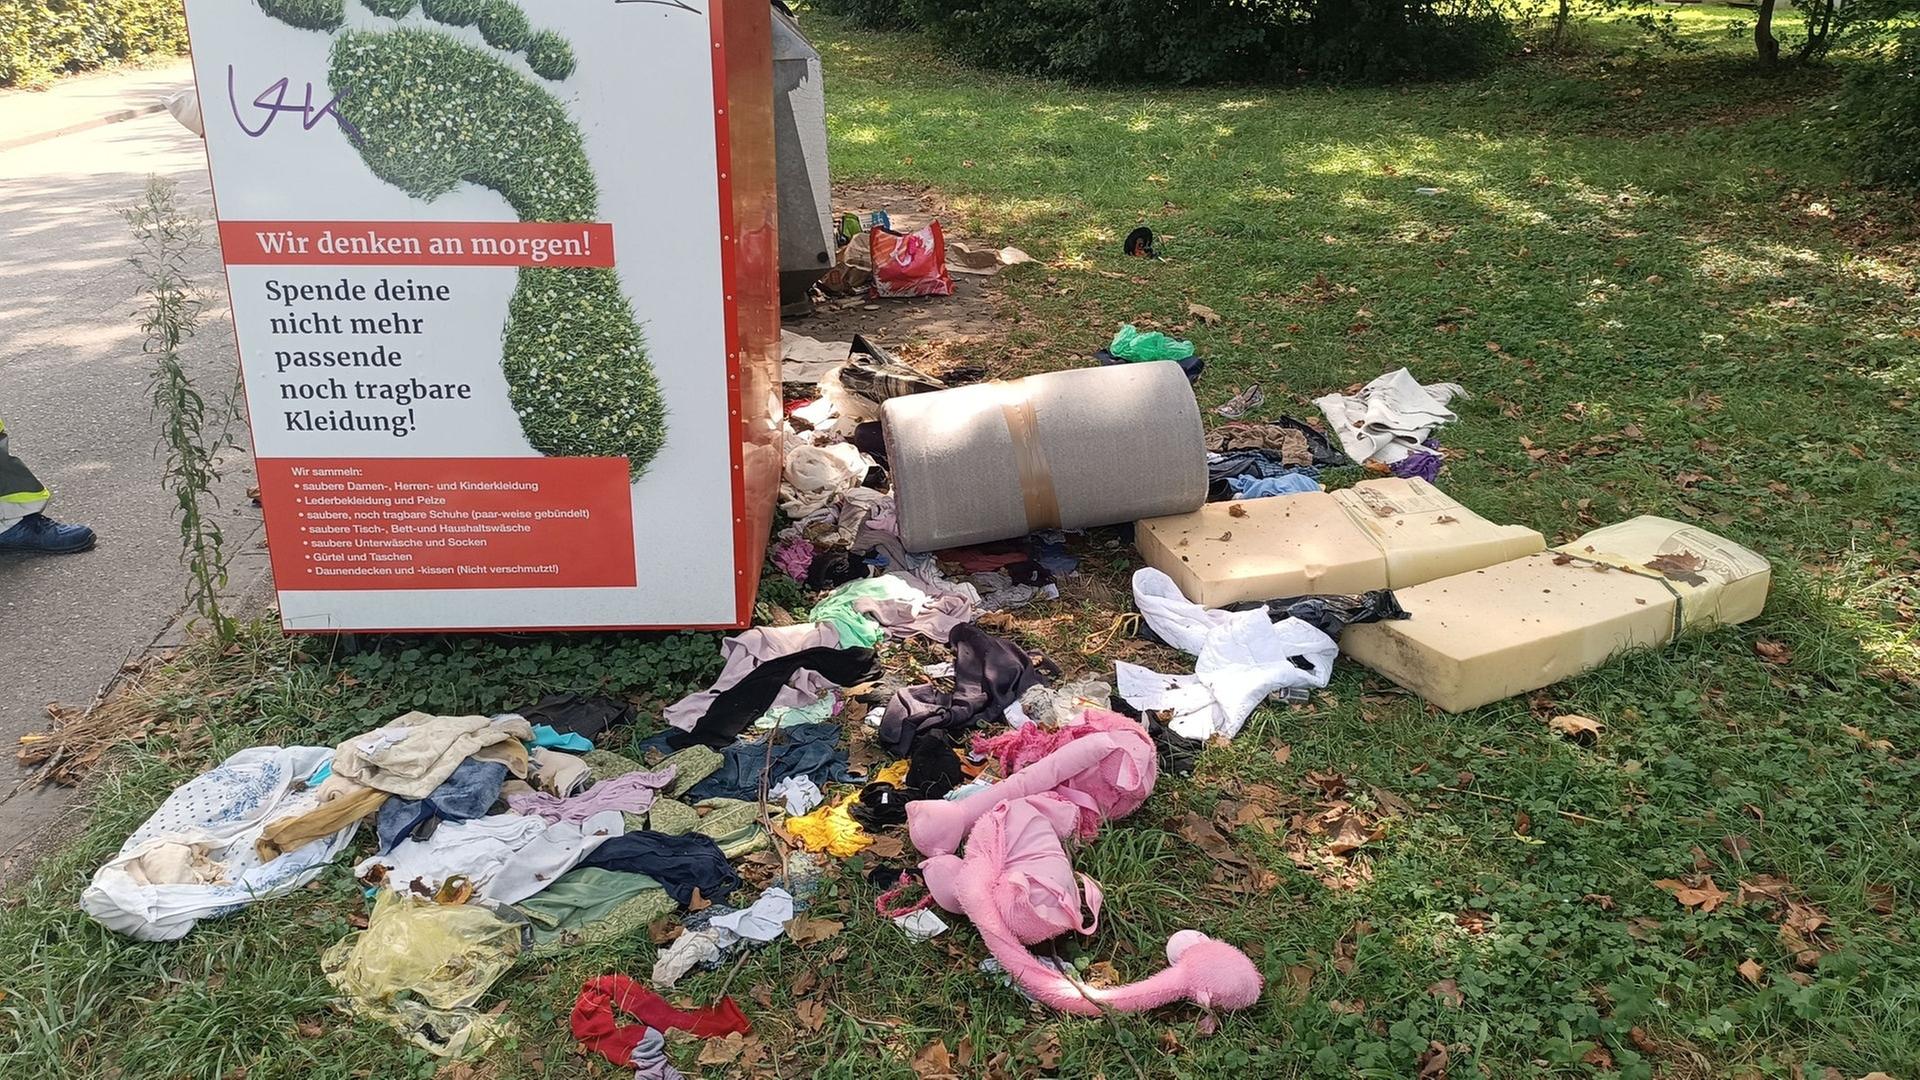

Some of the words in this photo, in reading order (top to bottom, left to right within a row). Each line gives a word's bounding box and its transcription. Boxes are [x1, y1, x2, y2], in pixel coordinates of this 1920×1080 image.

[256, 231, 308, 254] Wir
[317, 231, 421, 255] denken
[429, 237, 463, 255] an
[472, 231, 591, 261] morgen!
[266, 279, 366, 306] Spende
[374, 279, 450, 301] deine
[271, 313, 342, 334] nicht
[350, 313, 423, 335] mehr
[275, 346, 402, 372] passende
[280, 378, 346, 400] noch
[355, 379, 471, 405] tragbare
[284, 409, 416, 436] Kleidung!
[291, 467, 309, 476] Wir
[312, 467, 362, 476] sammeln:
[303, 482, 344, 490] saubere
[347, 482, 392, 491] Damen-,
[394, 482, 433, 490] Herren-
[437, 482, 457, 490] und
[460, 482, 538, 492] Kinderkleidung
[305, 496, 391, 506] Lederbekleidung
[395, 496, 414, 505] und
[417, 496, 445, 505] Pelze
[307, 511, 351, 520] saubere,
[354, 511, 380, 519] noch
[383, 511, 426, 520] tragbare
[429, 510, 468, 519] Schuhe
[472, 510, 531, 520] (paar-weise
[535, 510, 590, 520] gebündelt)
[309, 525, 350, 533] saubere
[352, 525, 388, 534] Tisch-,
[440, 524, 531, 533] Haushaltswäsche
[311, 539, 352, 548] saubere
[355, 539, 422, 547] Unterwäsche
[425, 538, 445, 547] und
[448, 538, 487, 546] Socken
[313, 553, 345, 561] Gürtel
[348, 552, 366, 561] und
[369, 552, 412, 561] Taschen
[316, 567, 392, 575] Daunendecken
[395, 566, 414, 575] und
[417, 566, 454, 574] -kissen
[457, 566, 487, 575] (Nicht
[490, 565, 559, 575] verschmutzt!)
